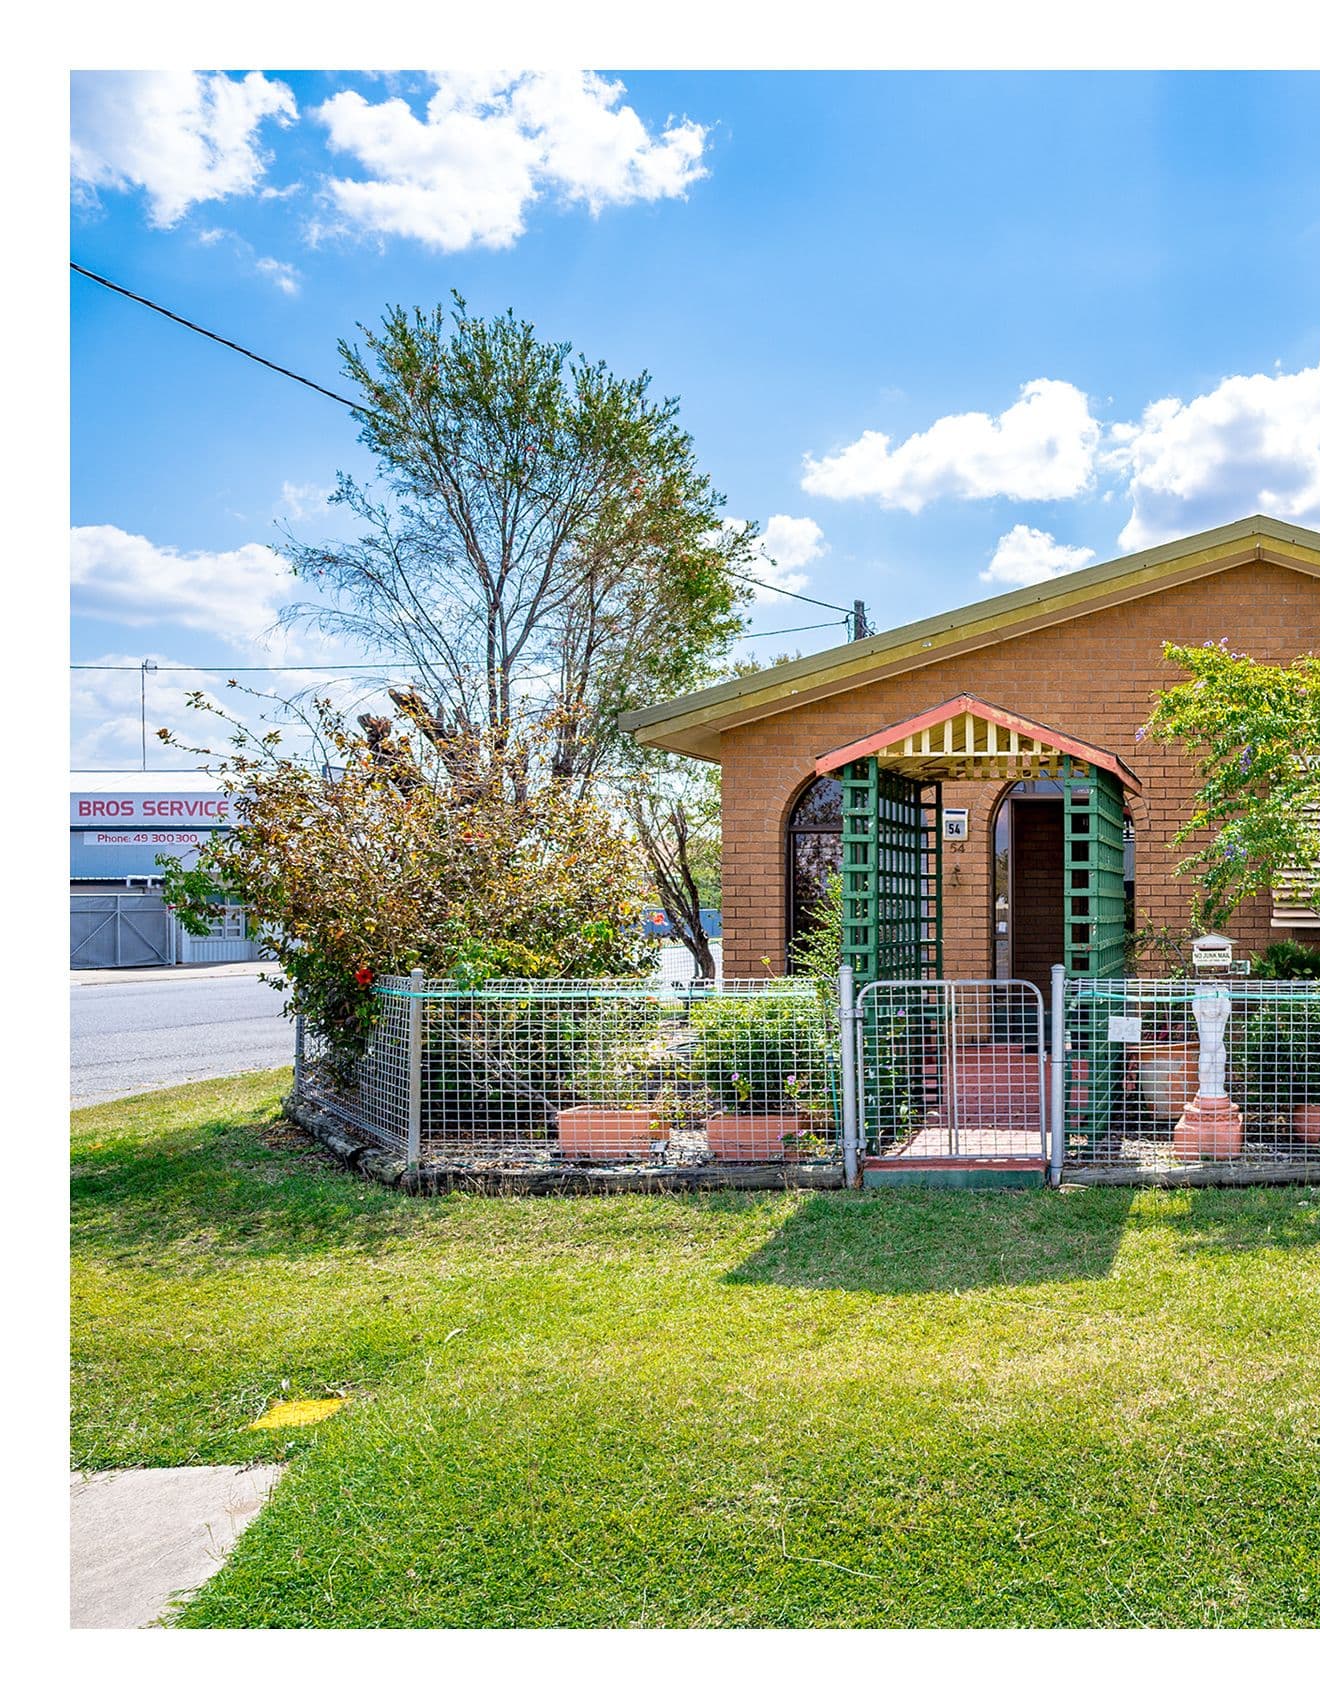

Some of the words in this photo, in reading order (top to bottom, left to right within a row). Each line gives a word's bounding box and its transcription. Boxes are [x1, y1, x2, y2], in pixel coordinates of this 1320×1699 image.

[78, 800, 134, 816] BROS
[142, 800, 229, 816] SERVICE
[948, 824, 960, 834] 54
[97, 833, 131, 843] Phone:
[133, 833, 148, 843] 49
[950, 843, 965, 853] 54
